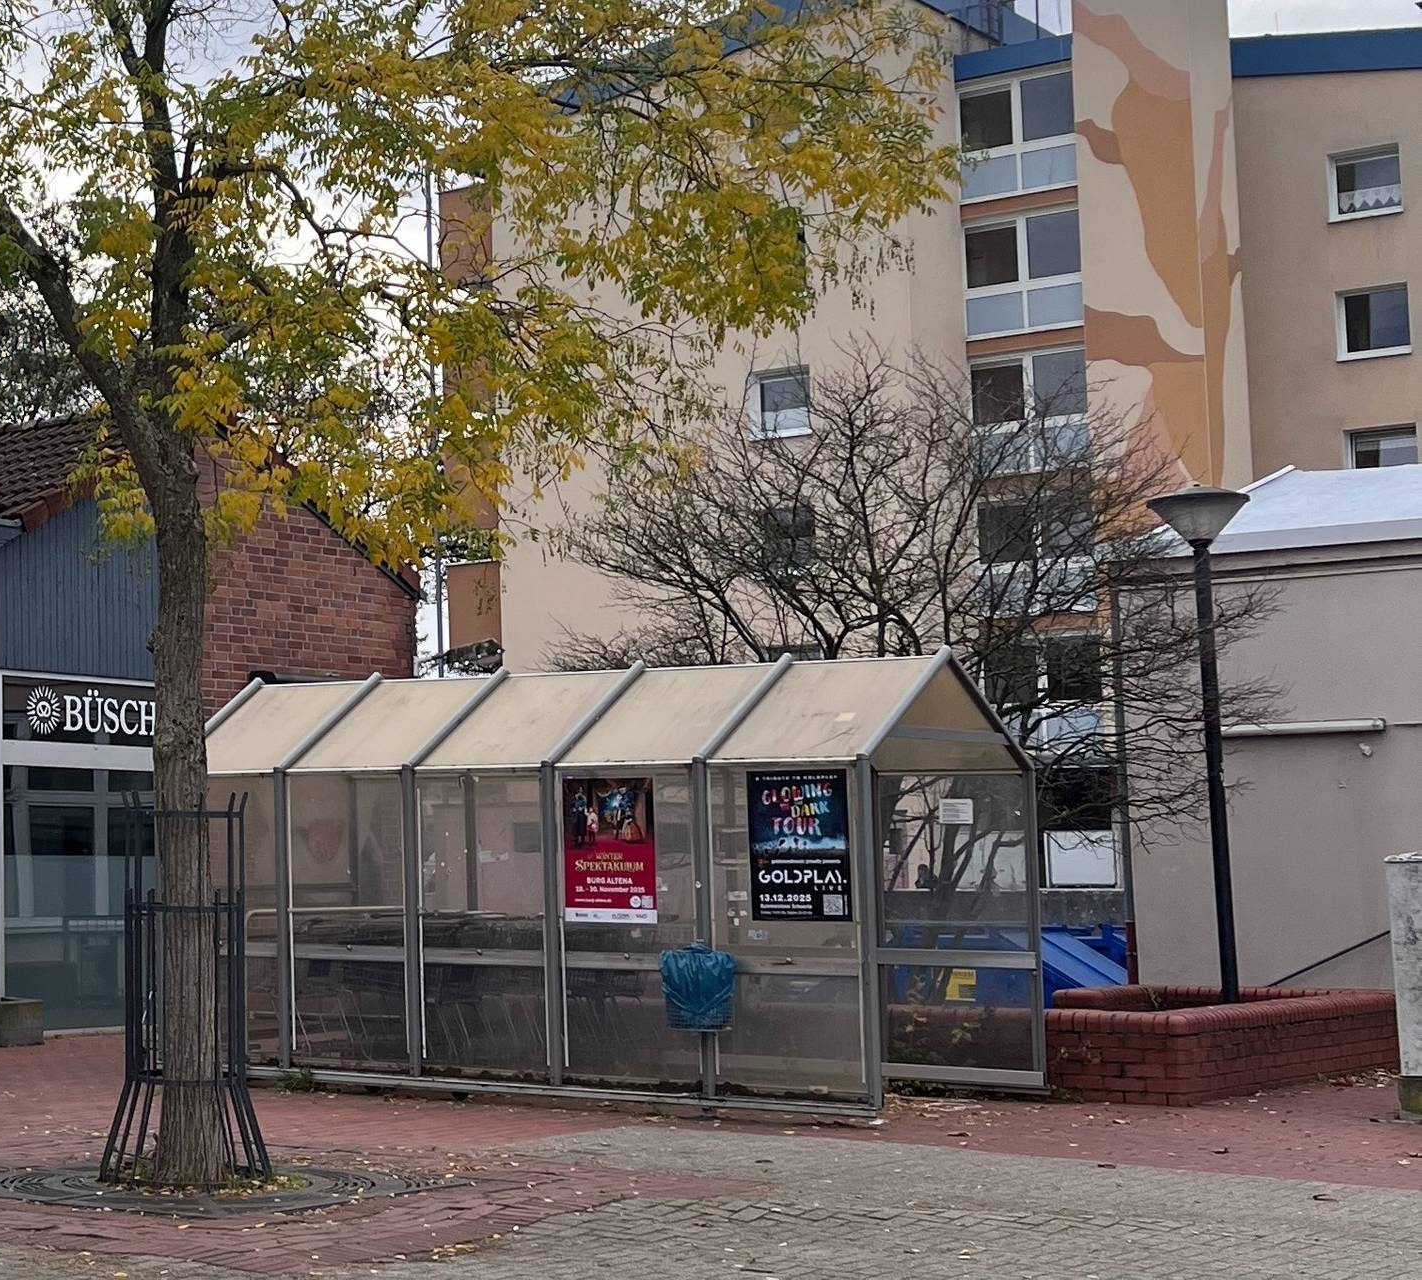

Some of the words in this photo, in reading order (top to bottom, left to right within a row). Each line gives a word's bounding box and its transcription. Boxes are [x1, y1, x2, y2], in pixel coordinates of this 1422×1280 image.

[63, 689, 156, 736] BÜSCH
[761, 782, 833, 805] GLOWING
[790, 800, 830, 818] DARK
[771, 816, 822, 836] TOUR
[586, 876, 606, 885] BURG
[606, 876, 633, 885] ALTENA
[759, 893, 812, 902] 13.12.2025
